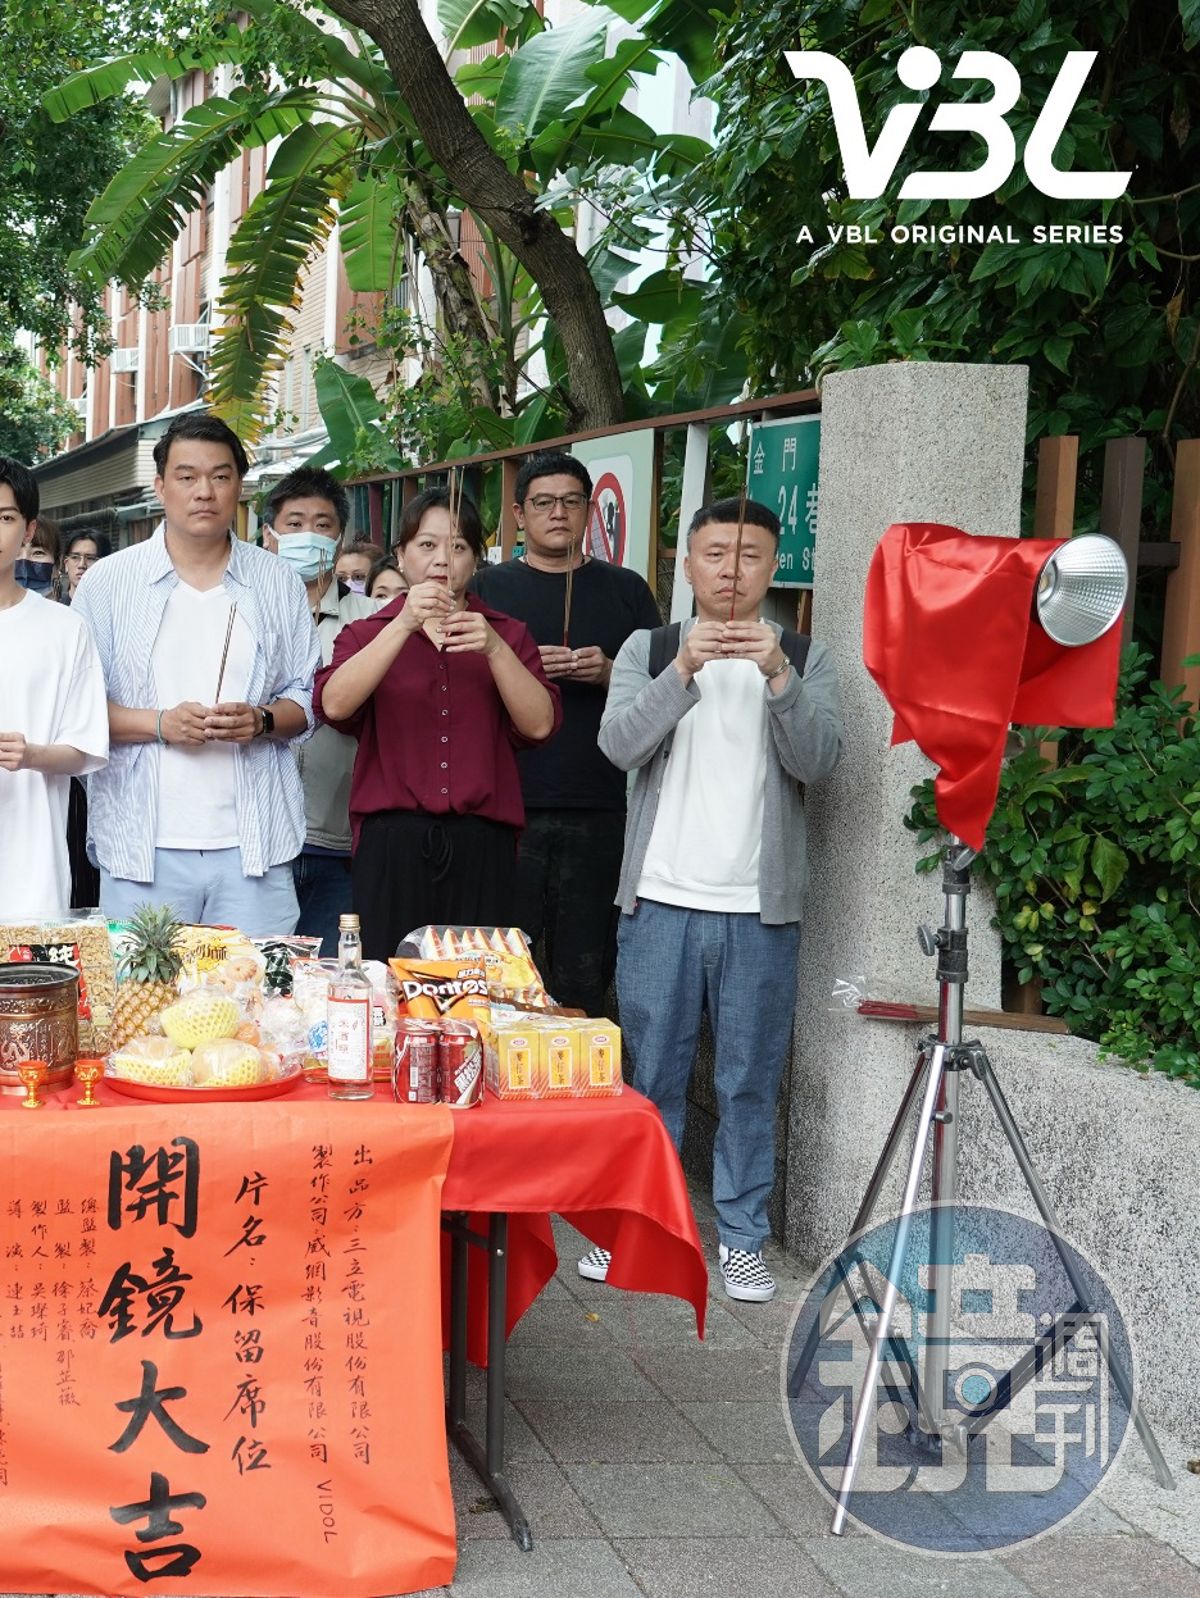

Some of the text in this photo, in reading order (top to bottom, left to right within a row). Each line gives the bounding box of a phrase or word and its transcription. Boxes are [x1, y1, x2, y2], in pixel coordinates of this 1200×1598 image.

[402, 979, 488, 1001] Doritos
[97, 1136, 210, 1583] 開鏡大吉
